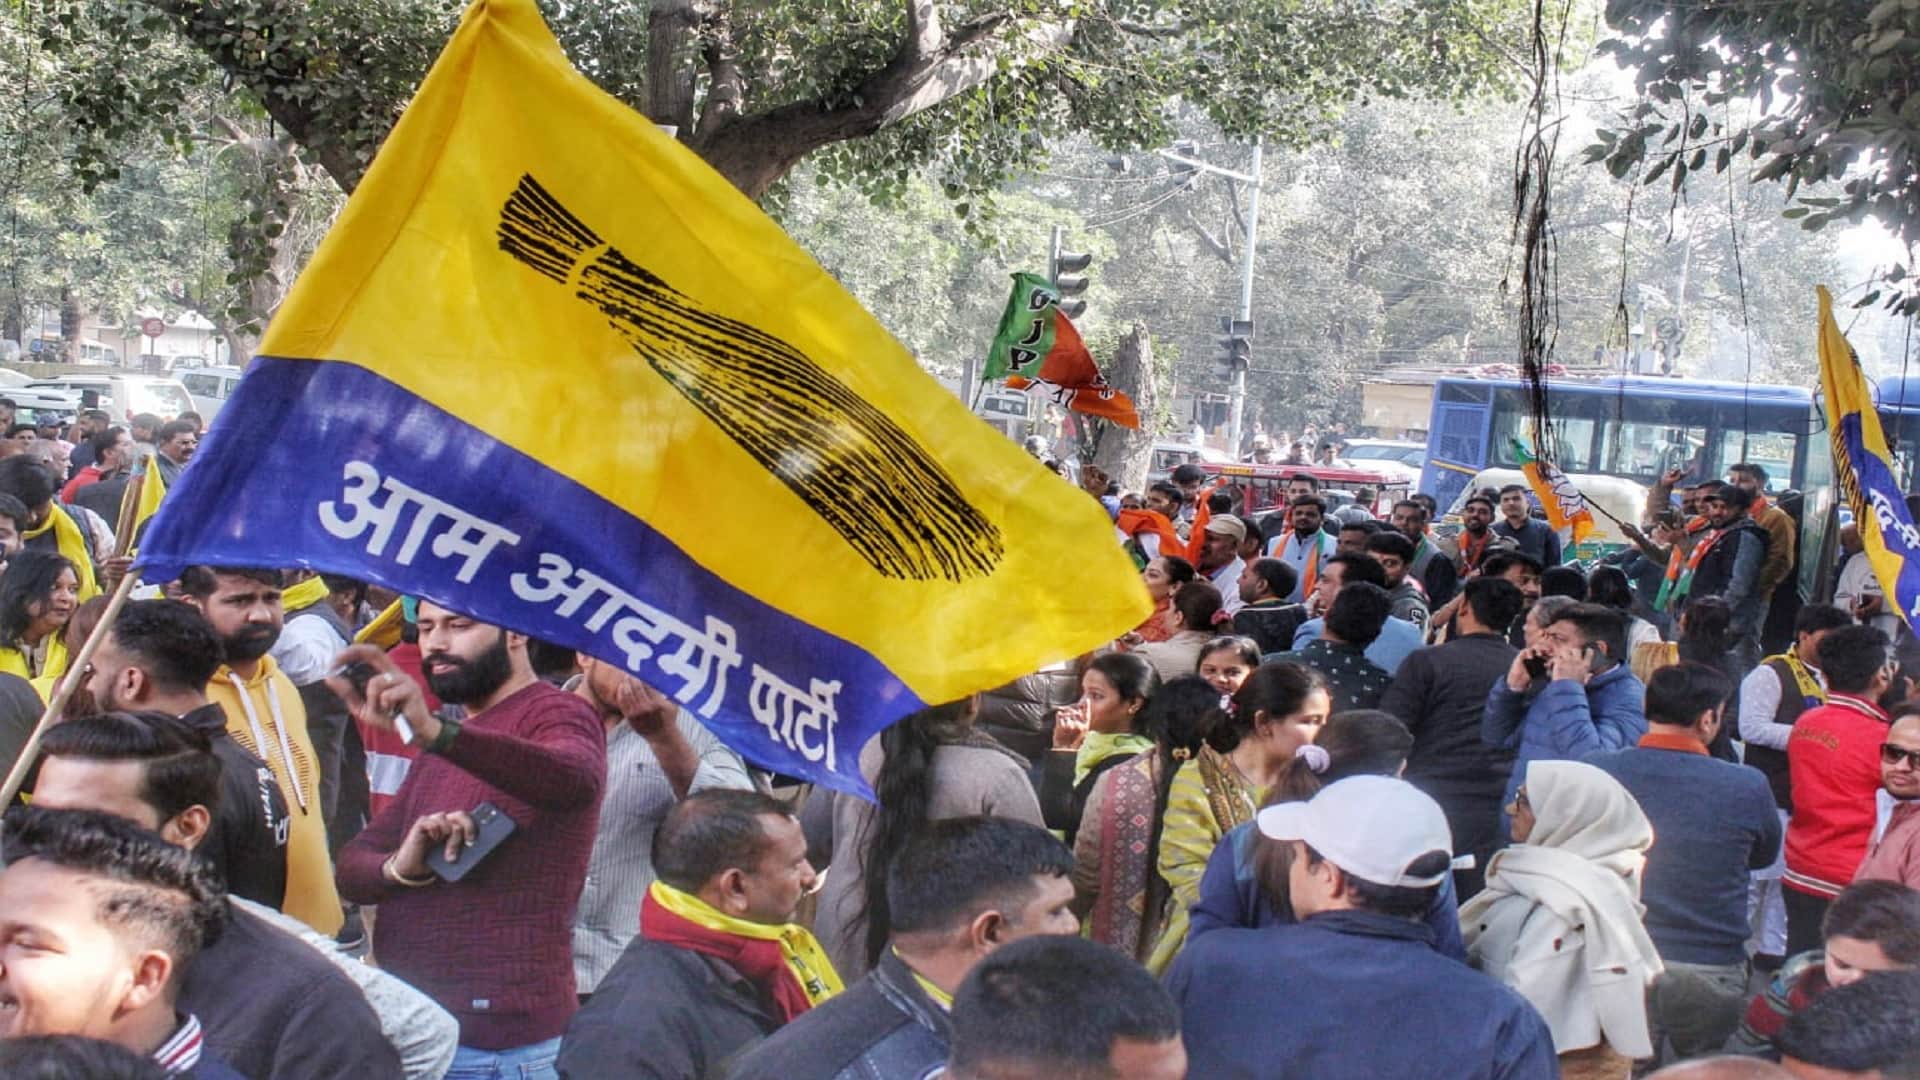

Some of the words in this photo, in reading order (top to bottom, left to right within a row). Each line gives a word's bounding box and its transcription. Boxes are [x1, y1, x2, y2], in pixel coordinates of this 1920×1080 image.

[317, 460, 521, 585] आम
[509, 552, 742, 720] आदमी
[748, 662, 842, 773] पार्टी
